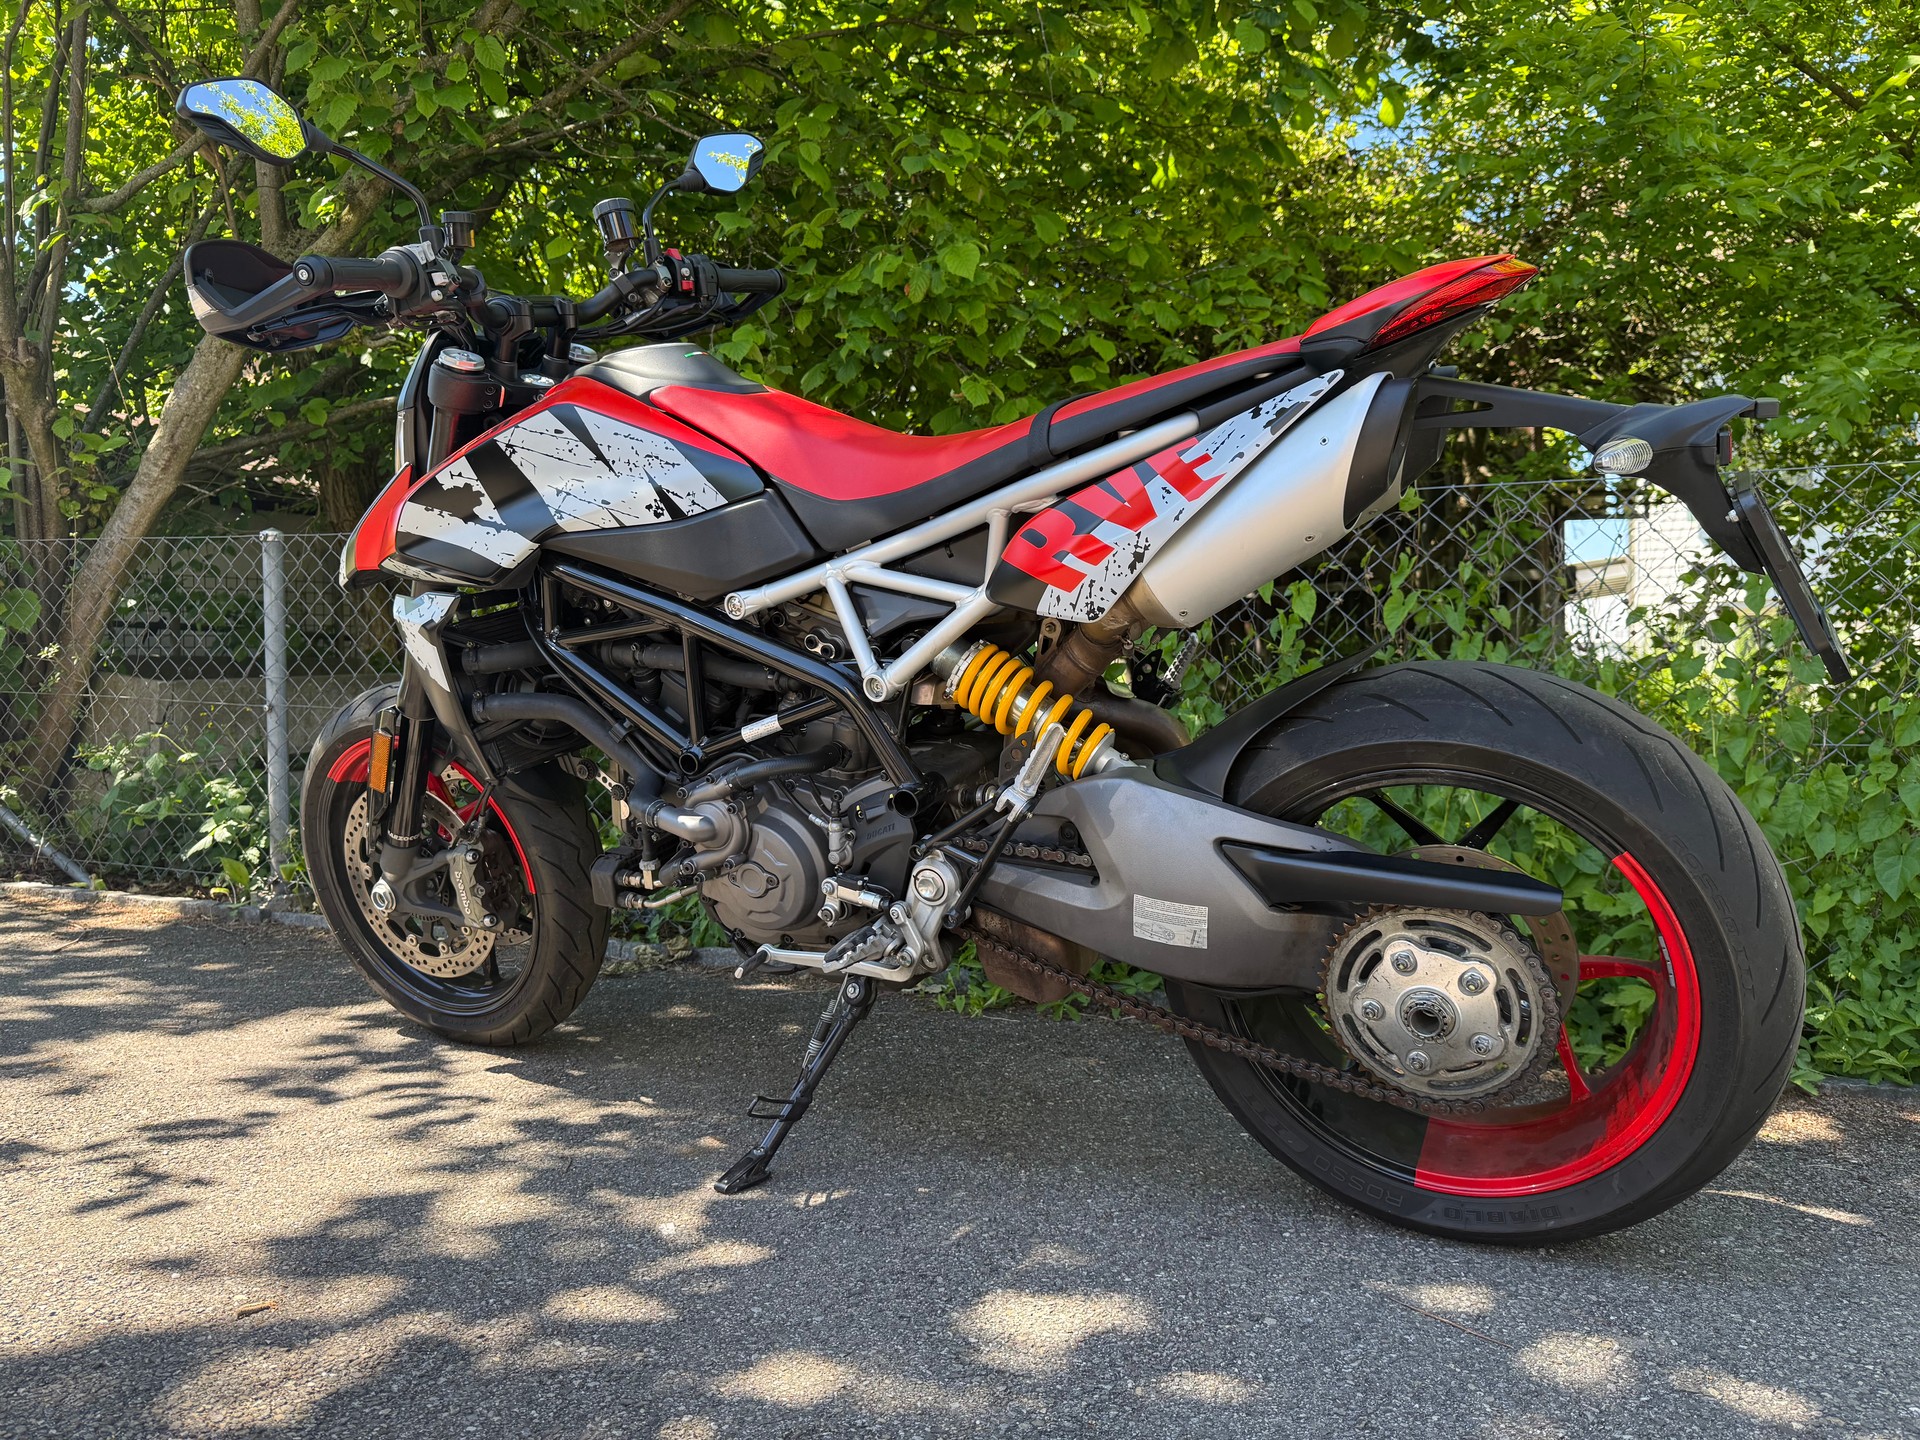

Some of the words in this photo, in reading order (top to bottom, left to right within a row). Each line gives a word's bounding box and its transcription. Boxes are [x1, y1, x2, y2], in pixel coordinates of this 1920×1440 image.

[1001, 437, 1227, 593] RVE
[866, 822, 896, 840] DUCATI
[454, 871, 471, 914] brembo
[1313, 1155, 1404, 1207] ROSSO
[1443, 1205, 1560, 1224] DIABLO
